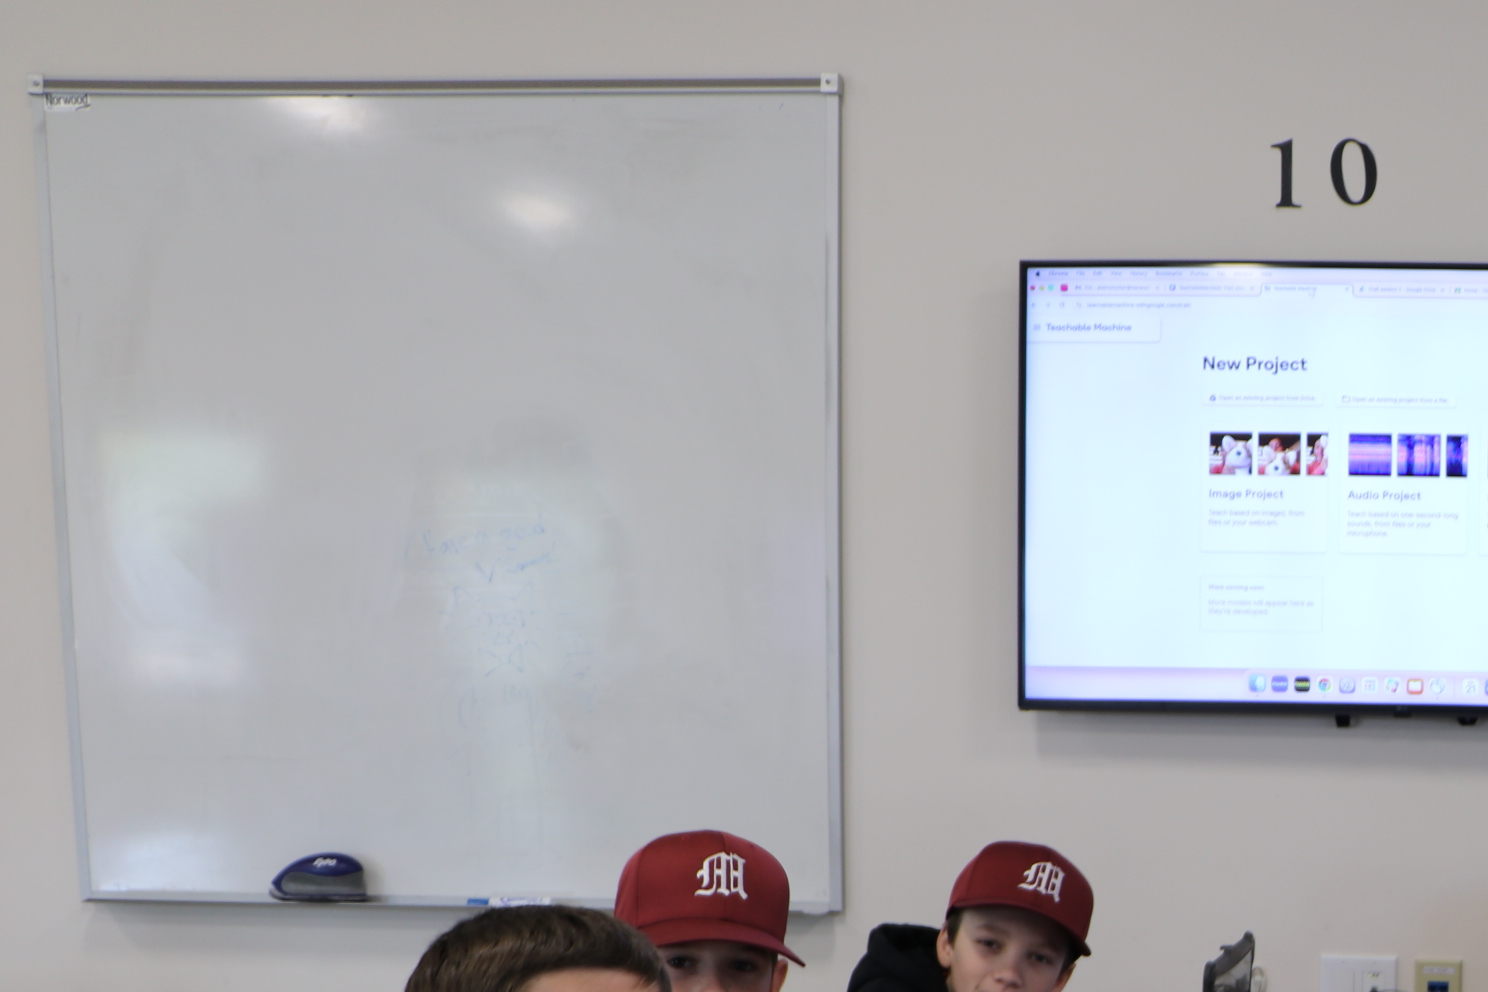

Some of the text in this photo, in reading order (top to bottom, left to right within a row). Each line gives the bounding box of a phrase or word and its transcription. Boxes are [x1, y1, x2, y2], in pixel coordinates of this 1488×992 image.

[1270, 137, 1378, 208] 10
[1046, 322, 1132, 332] Teachable Machine
[1203, 356, 1308, 375] New Project
[1208, 489, 1284, 501] Image Project
[1347, 490, 1421, 502] Audio Project
